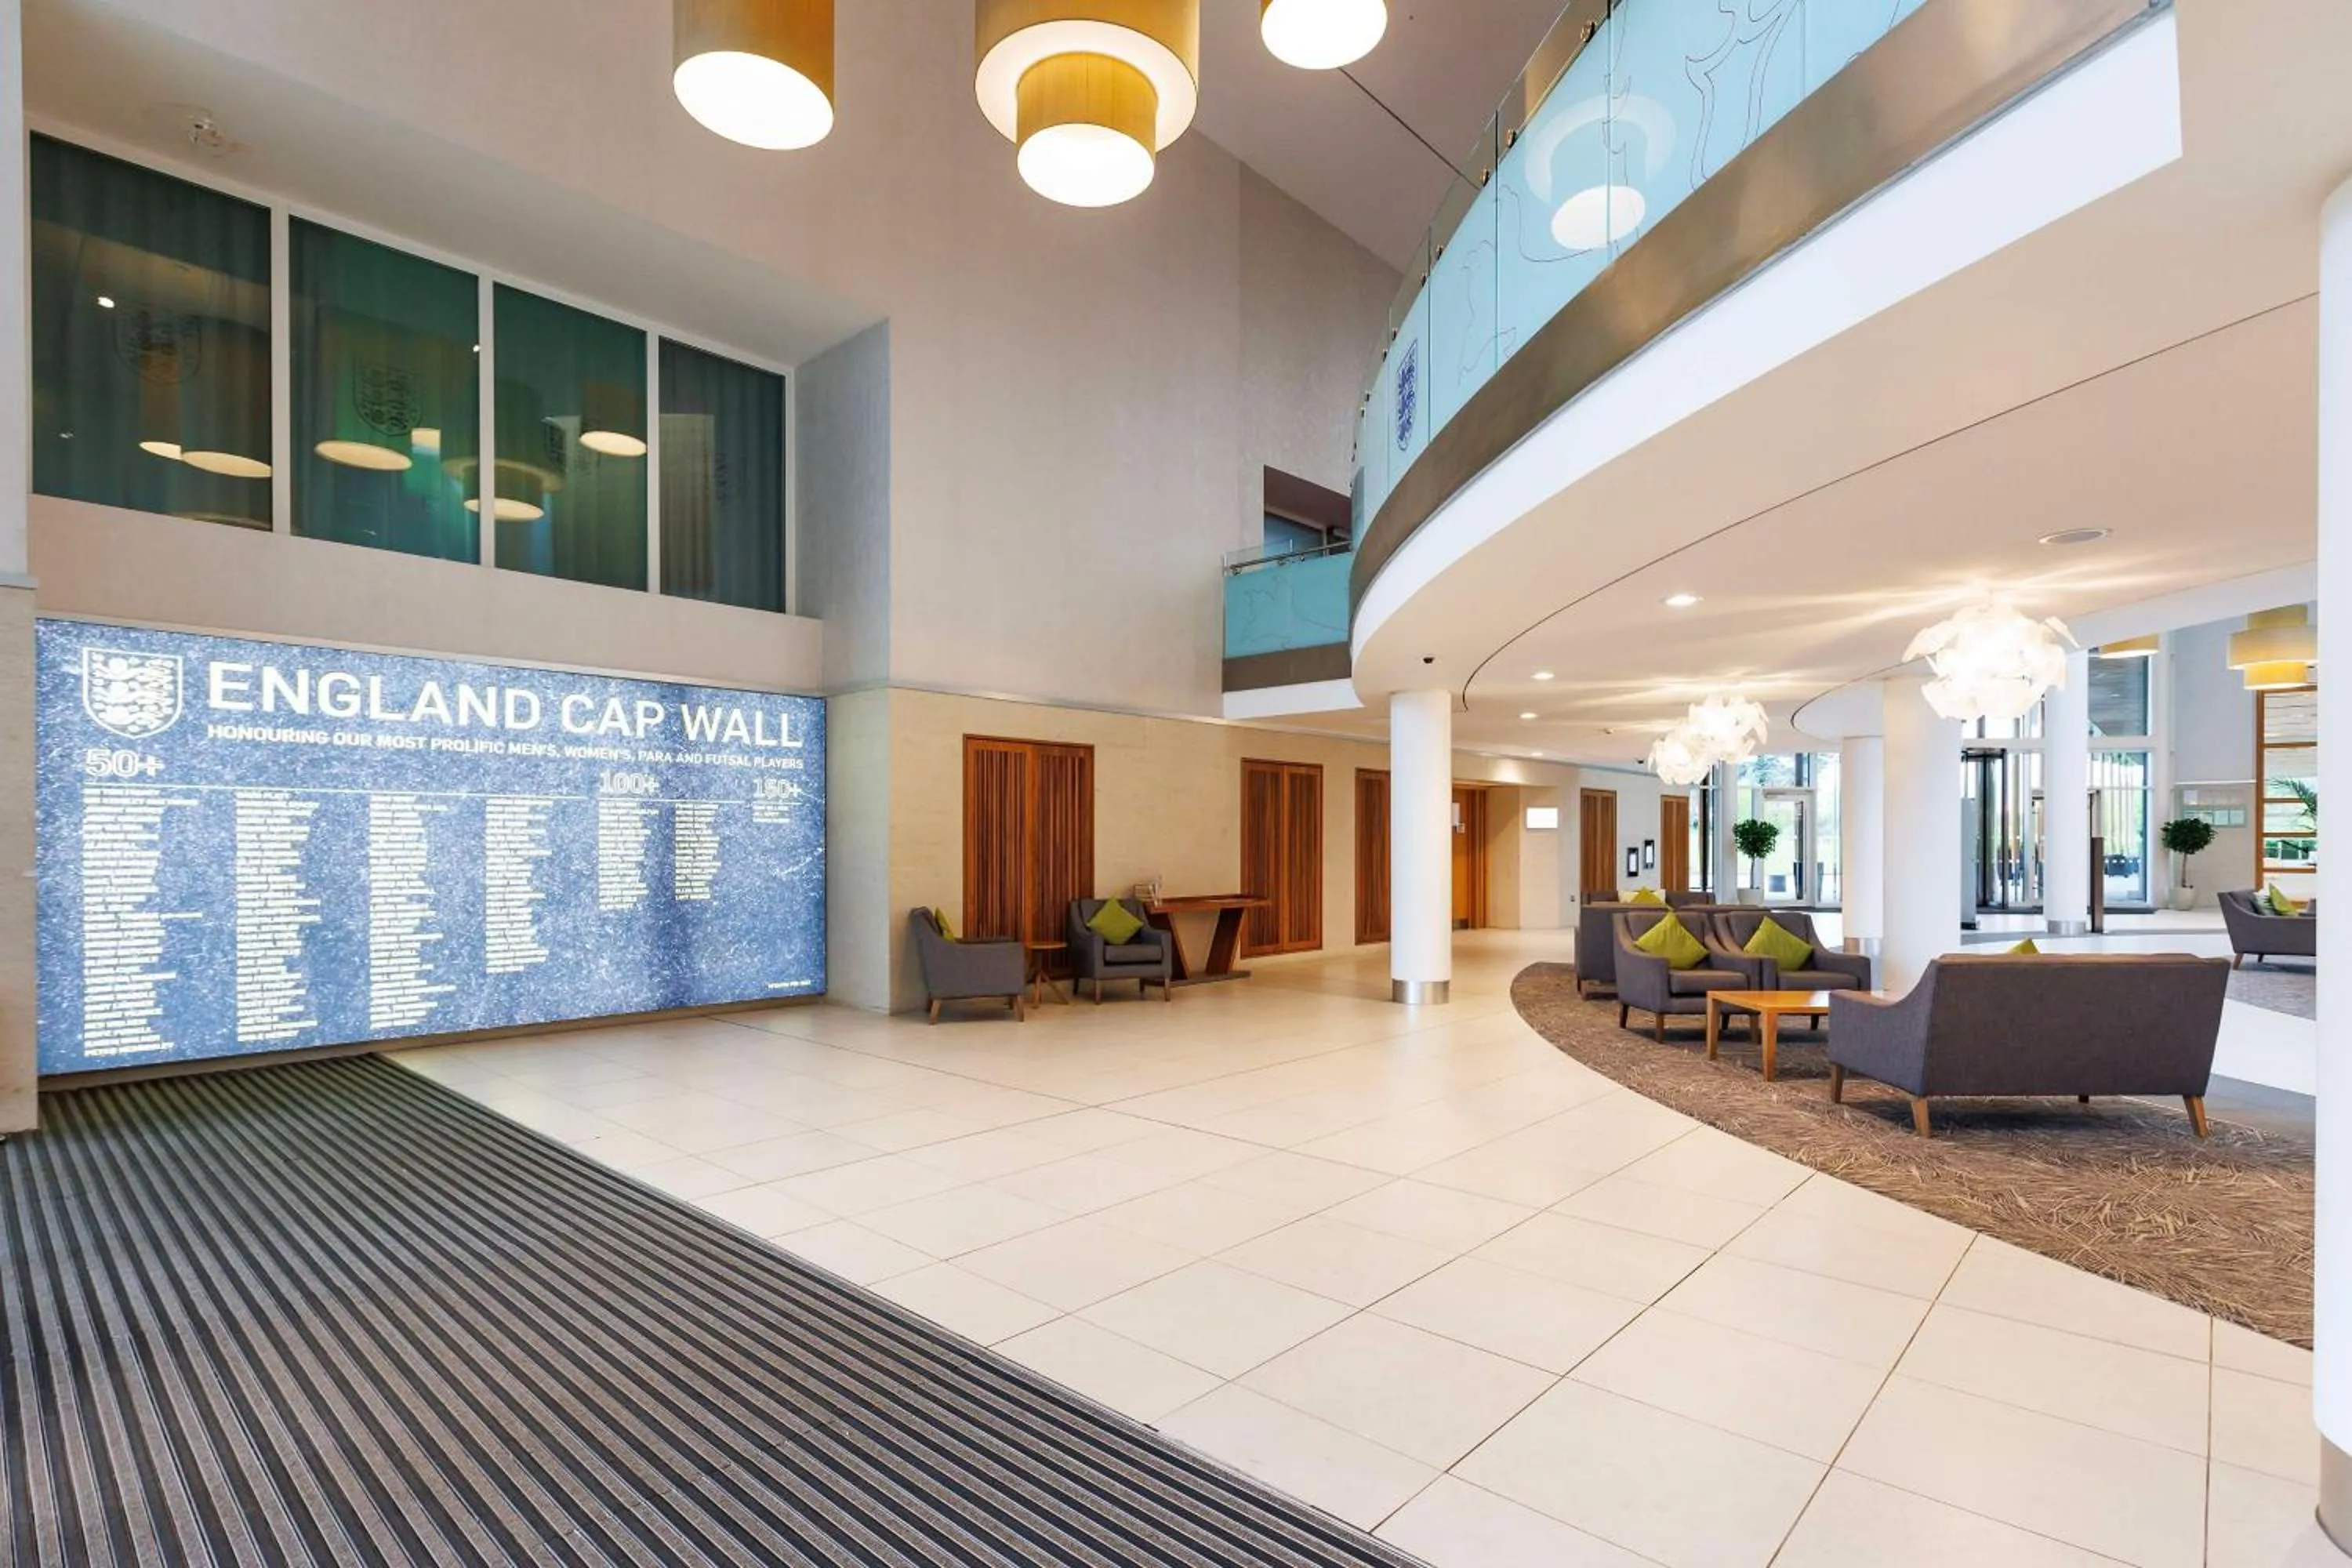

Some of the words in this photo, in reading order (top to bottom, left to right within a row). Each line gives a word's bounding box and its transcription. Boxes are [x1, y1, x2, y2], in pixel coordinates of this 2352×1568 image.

[209, 661, 540, 730] ENGLAND
[561, 694, 666, 739] CAP
[681, 704, 803, 747] WALL
[86, 749, 165, 778] 50+
[208, 724, 329, 744] HONOURING
[332, 731, 372, 746] OUR
[377, 735, 427, 749] MOST
[431, 738, 504, 754] PROLIFIC
[638, 750, 672, 762] PARA
[676, 753, 702, 764] AND
[706, 754, 750, 767] FUTSAL
[754, 757, 804, 769] PLAYERS
[600, 770, 659, 794] 100+
